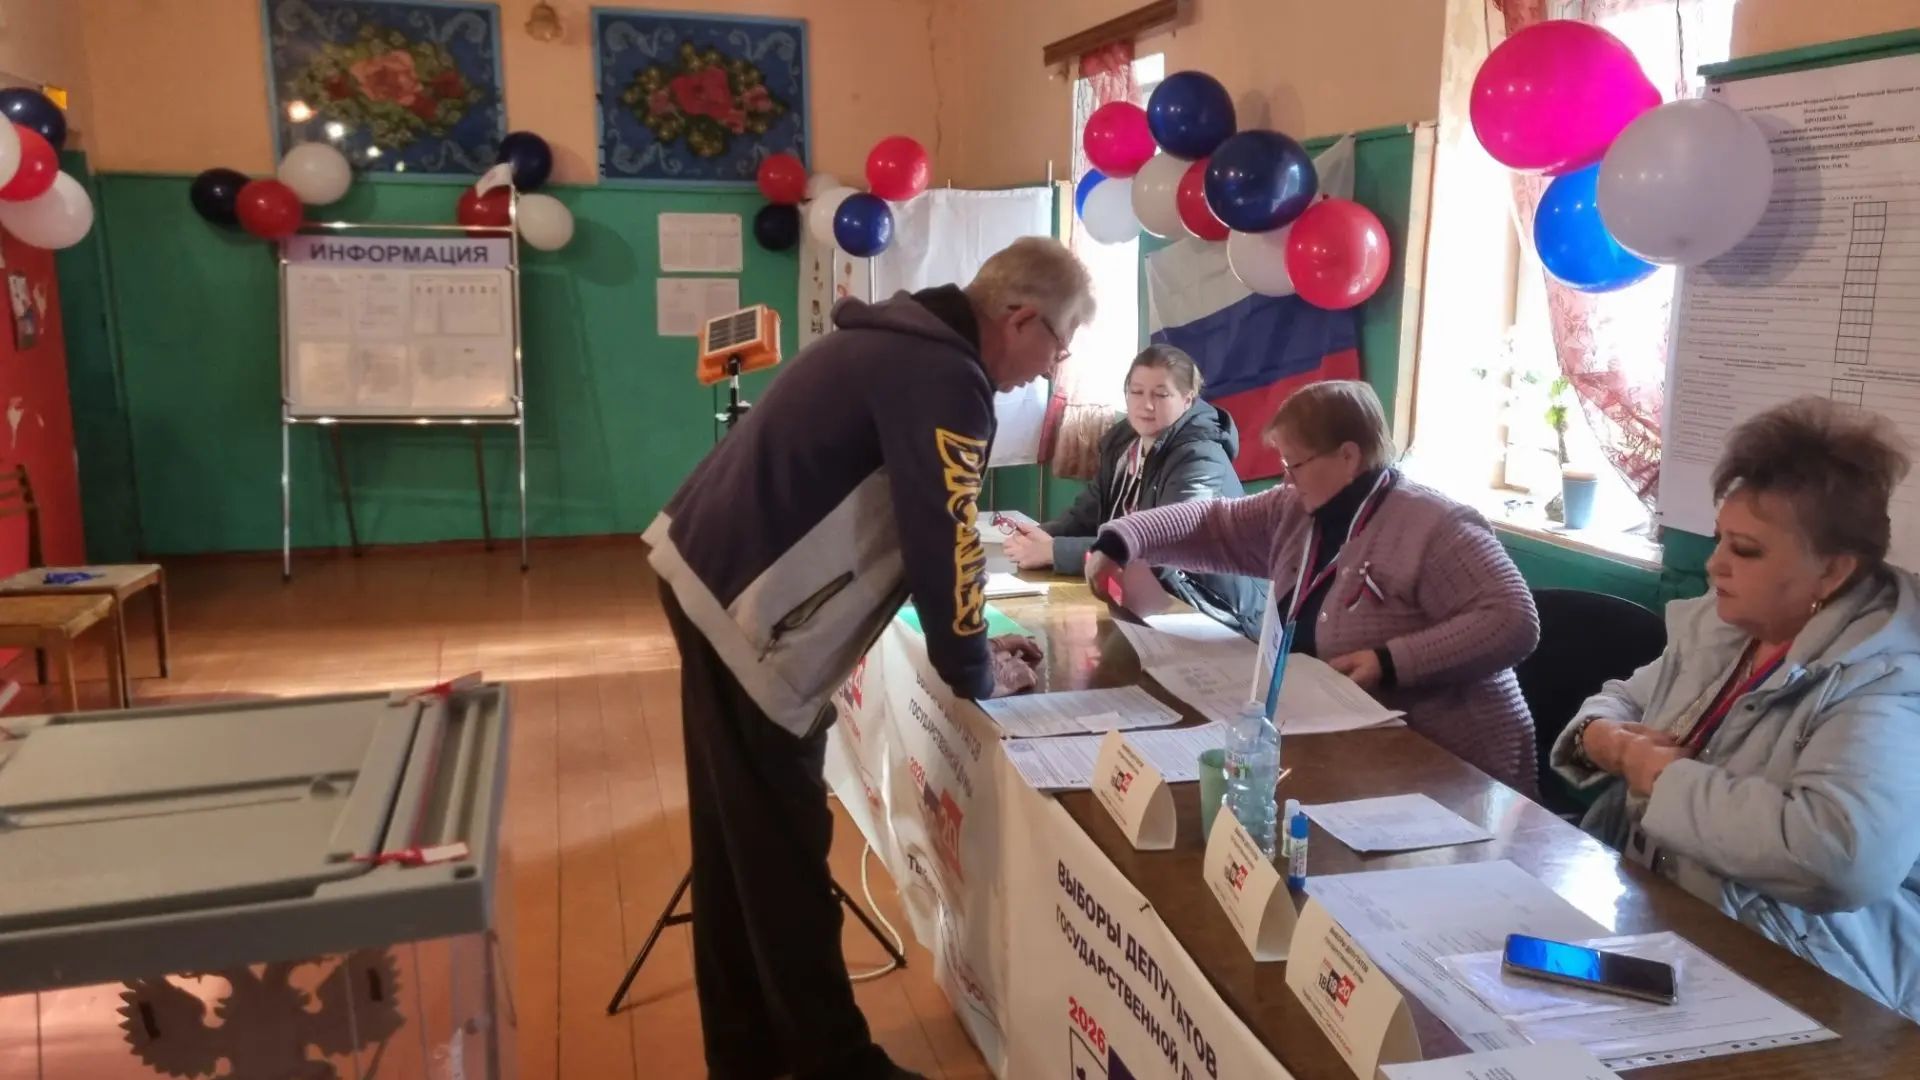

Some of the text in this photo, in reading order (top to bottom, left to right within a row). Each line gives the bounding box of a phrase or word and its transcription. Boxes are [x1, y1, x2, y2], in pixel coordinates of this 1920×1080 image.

[310, 244, 488, 265] ИНФОРМАЦИЯ
[1055, 903, 1178, 1074] ГОСУДАРСТВЕННОЙ
[1057, 859, 1121, 949] ВЫБОРЫ
[1125, 933, 1218, 1080] ДЕПУТАТОВ
[1068, 995, 1106, 1056] 2026
